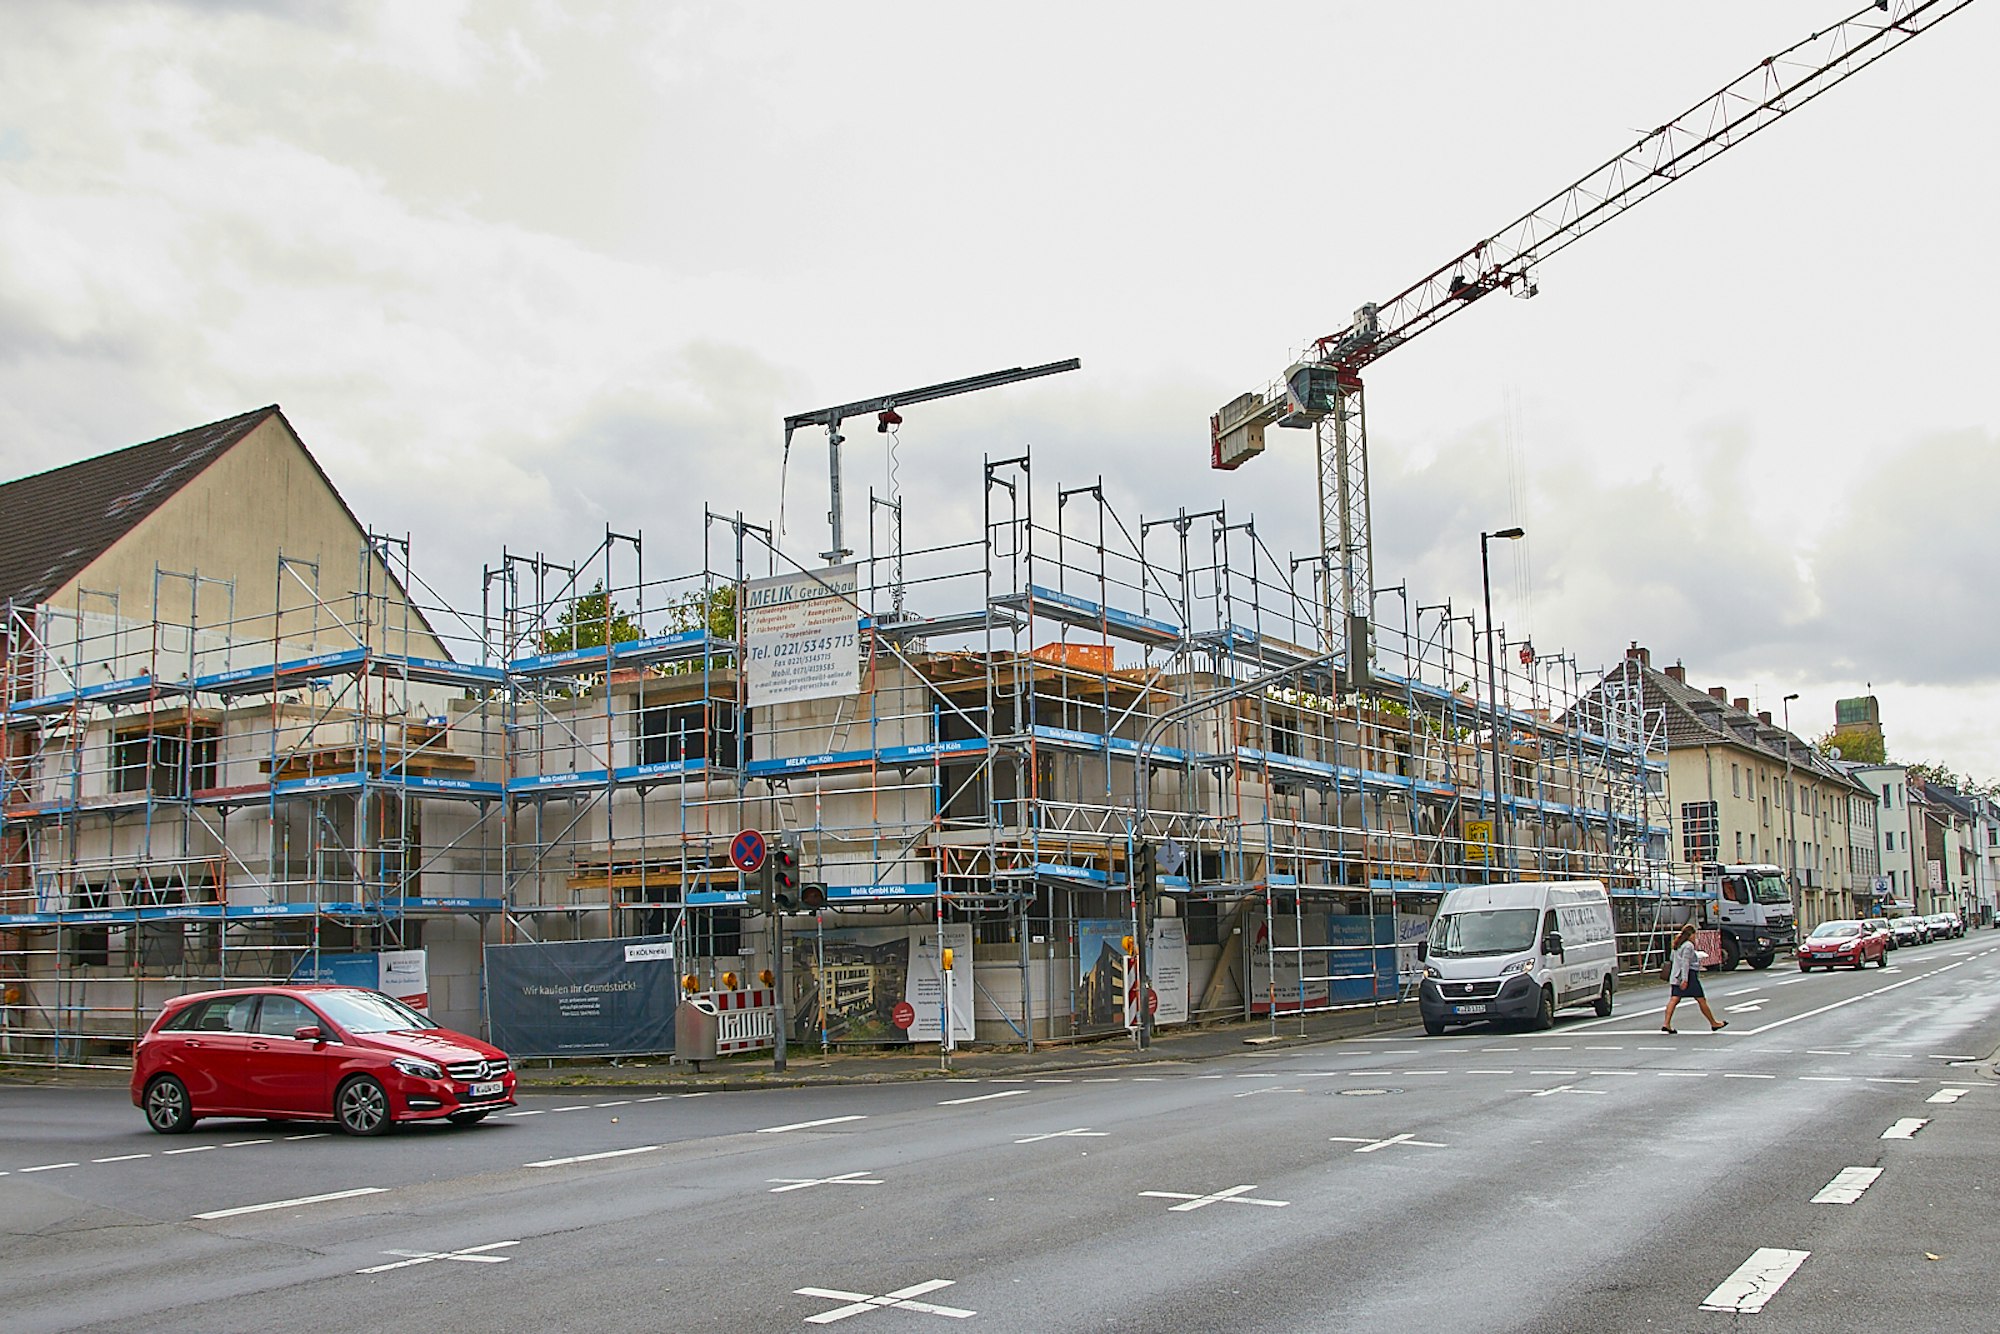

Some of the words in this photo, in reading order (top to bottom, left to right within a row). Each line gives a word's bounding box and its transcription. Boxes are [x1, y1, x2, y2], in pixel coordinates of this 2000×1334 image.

[750, 585, 794, 607] MELIK
[752, 645, 771, 661] Tel.
[774, 660, 786, 668] Fax
[945, 742, 961, 750] Köln
[785, 758, 808, 767] MELIK
[818, 755, 834, 763] Köln
[638, 766, 653, 774] Melik
[653, 764, 670, 772] GmbH
[422, 778, 438, 786] Melik
[438, 779, 457, 788] GmbH
[539, 776, 552, 784] Melik
[552, 775, 567, 783] GmbH
[850, 888, 867, 896] Melik
[867, 887, 889, 895] GmbH
[889, 886, 906, 894] Köln
[725, 892, 741, 901] Melik
[521, 985, 539, 996] Wir
[540, 983, 569, 995] kaufen
[570, 982, 582, 994] Ihr
[583, 981, 637, 994] Grundstück!
